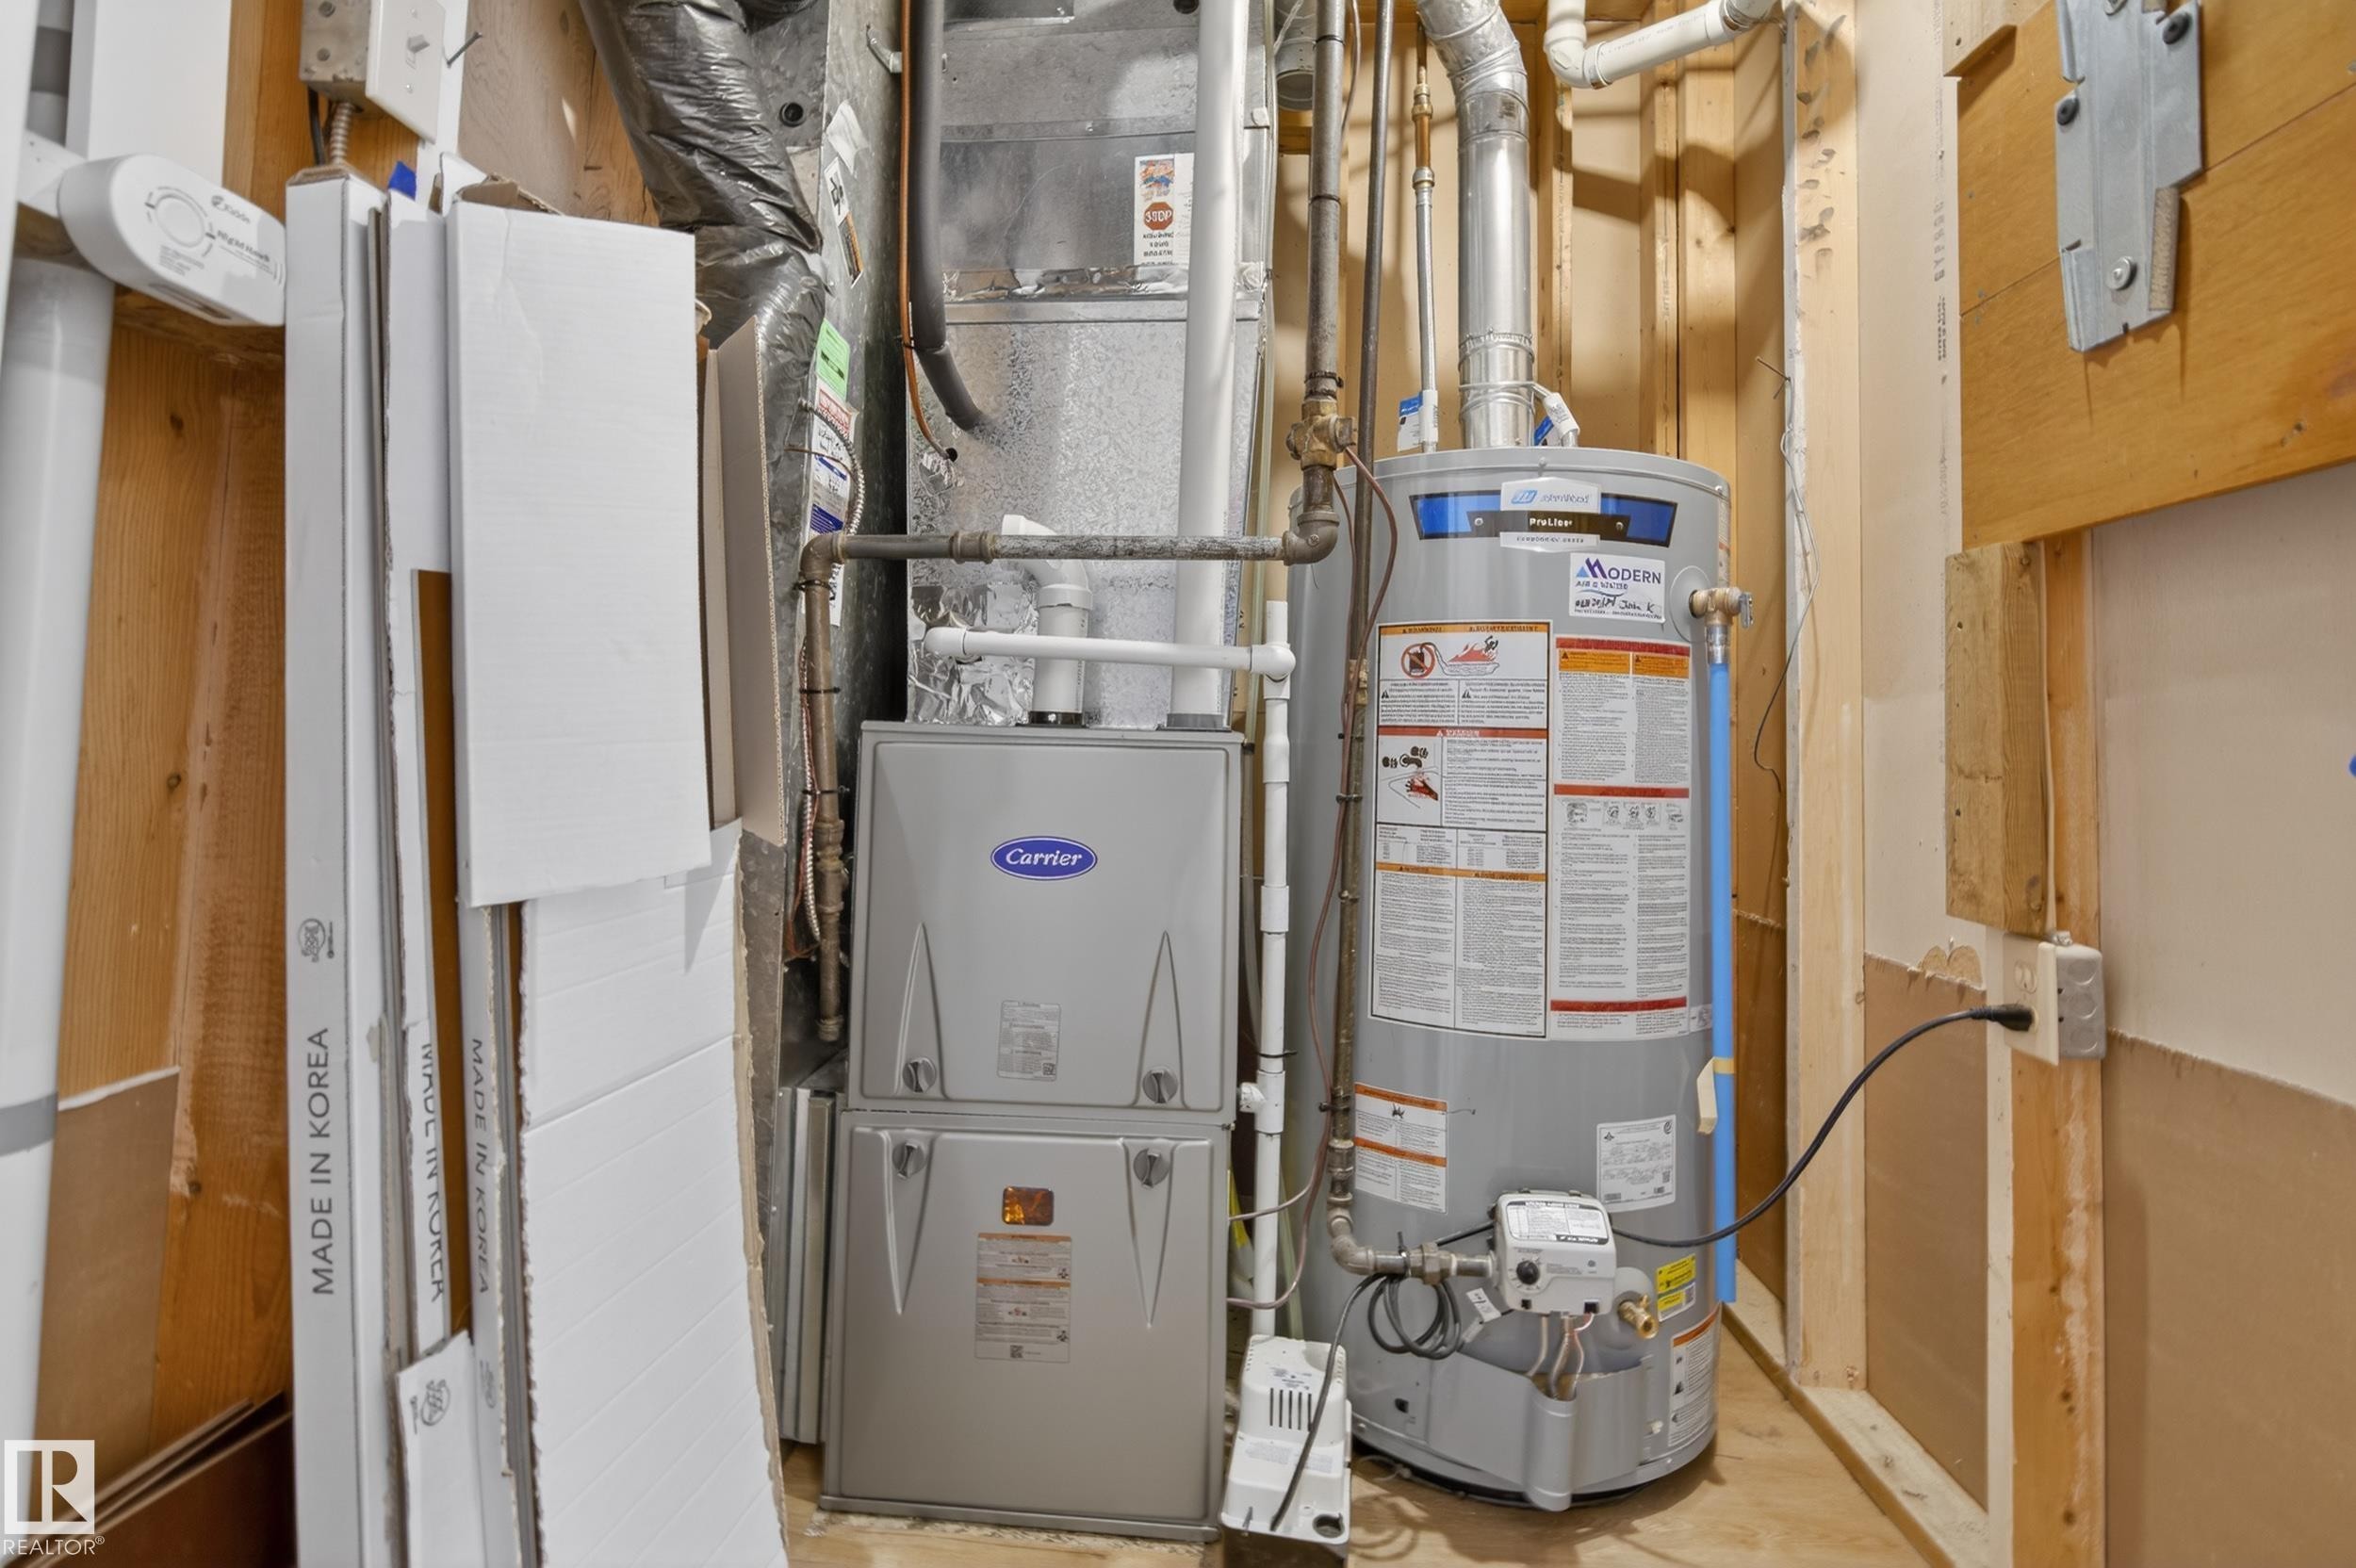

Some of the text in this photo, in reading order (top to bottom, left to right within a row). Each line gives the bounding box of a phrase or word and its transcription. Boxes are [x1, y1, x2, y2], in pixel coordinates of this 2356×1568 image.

[1145, 210, 1172, 222] STOP
[1585, 557, 1661, 584] MODERN
[1006, 848, 1083, 866] Carrier
[307, 1027, 335, 1295] MADE IN KOREA
[471, 1038, 489, 1295] MADE IN KOREA
